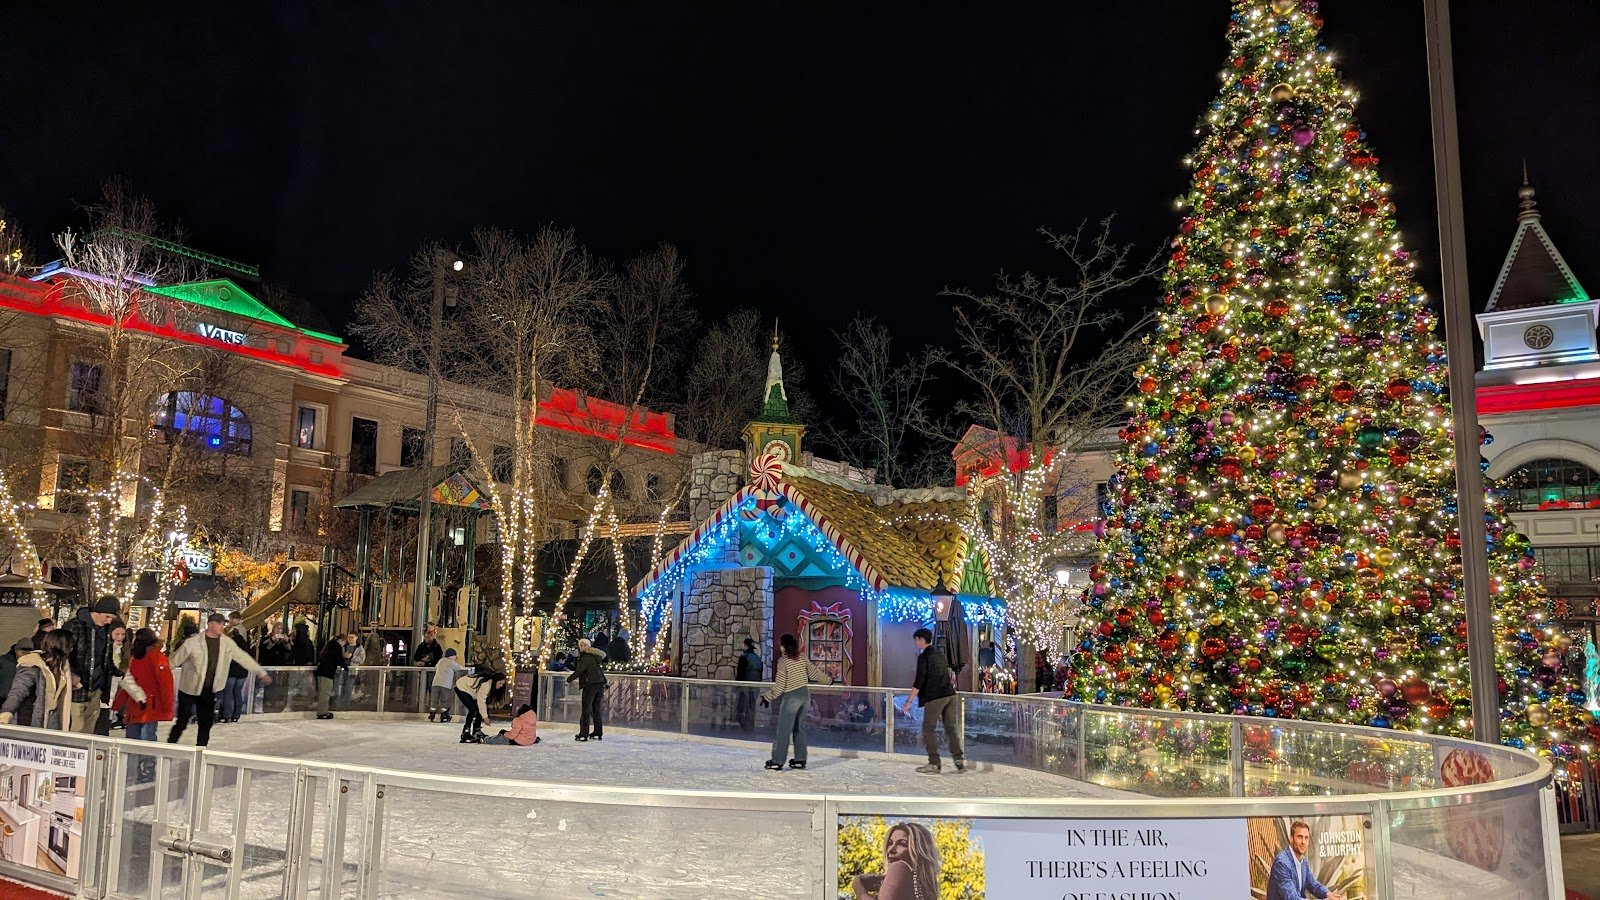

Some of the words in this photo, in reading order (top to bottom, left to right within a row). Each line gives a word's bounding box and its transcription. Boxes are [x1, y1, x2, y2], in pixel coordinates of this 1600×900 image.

[201, 322, 244, 345] VANS
[11, 744, 47, 764] TOWNHOMES
[1067, 829, 1086, 847] IN
[1090, 829, 1129, 847] THE
[1132, 829, 1168, 850] AIR,
[1318, 830, 1361, 844] JOHNSTON
[1025, 860, 1108, 879] THERE’S
[1111, 861, 1125, 878] A
[1129, 860, 1208, 878] FEELING
